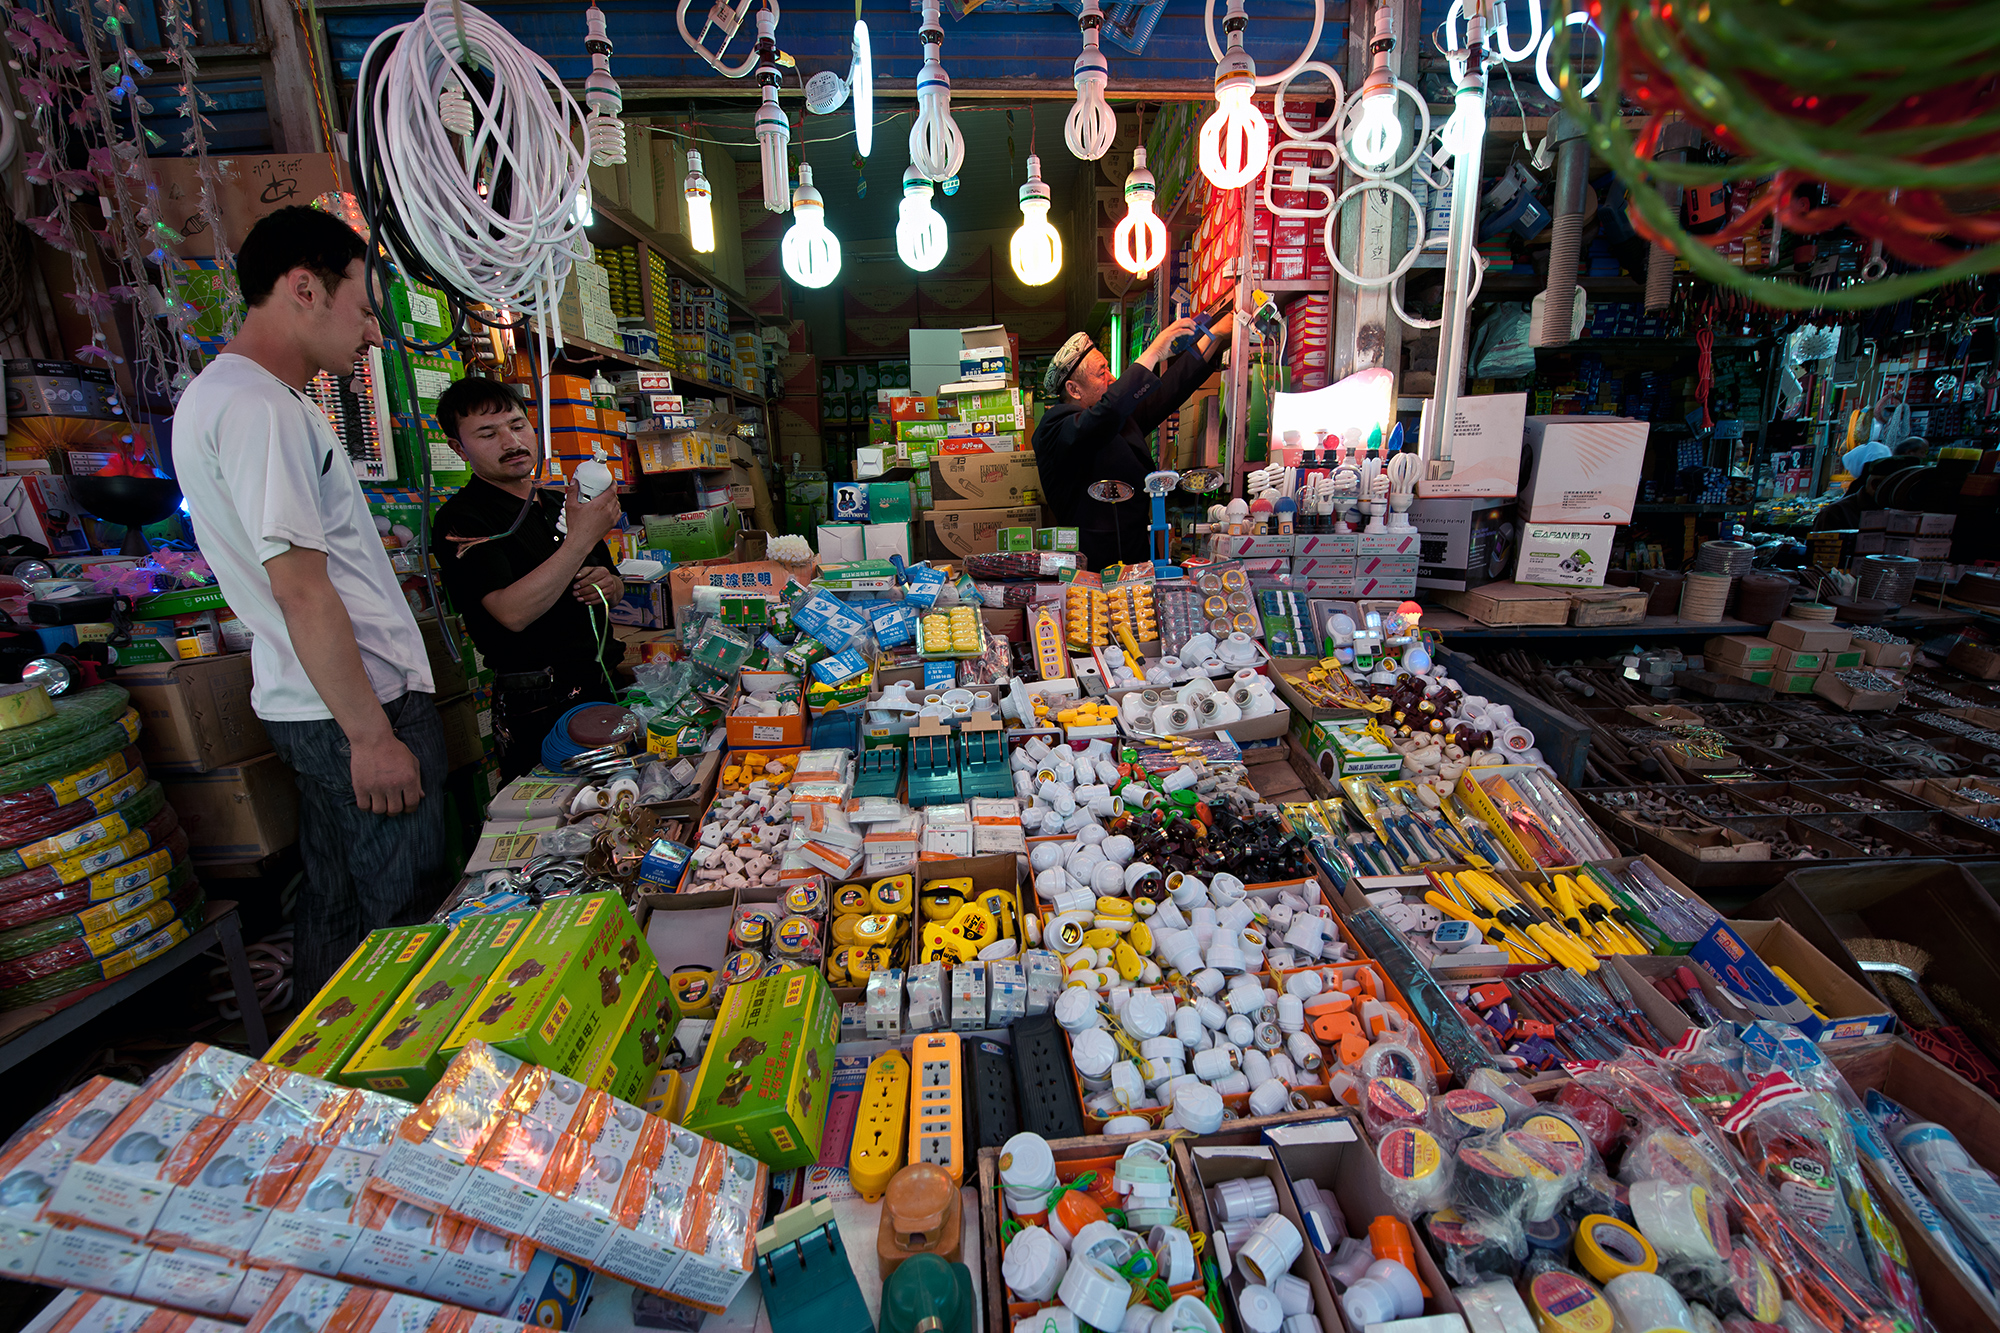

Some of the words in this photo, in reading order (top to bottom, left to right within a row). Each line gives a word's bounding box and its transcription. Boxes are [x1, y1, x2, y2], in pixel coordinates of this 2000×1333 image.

[980, 464, 1009, 473] ELECTRONIC
[1533, 530, 1570, 539] EAFAN
[1477, 798, 1492, 818] XIAO
[1511, 844, 1530, 869] TOOLS
[645, 873, 671, 885] FASTENER
[1792, 1161, 1822, 1175] CQC
